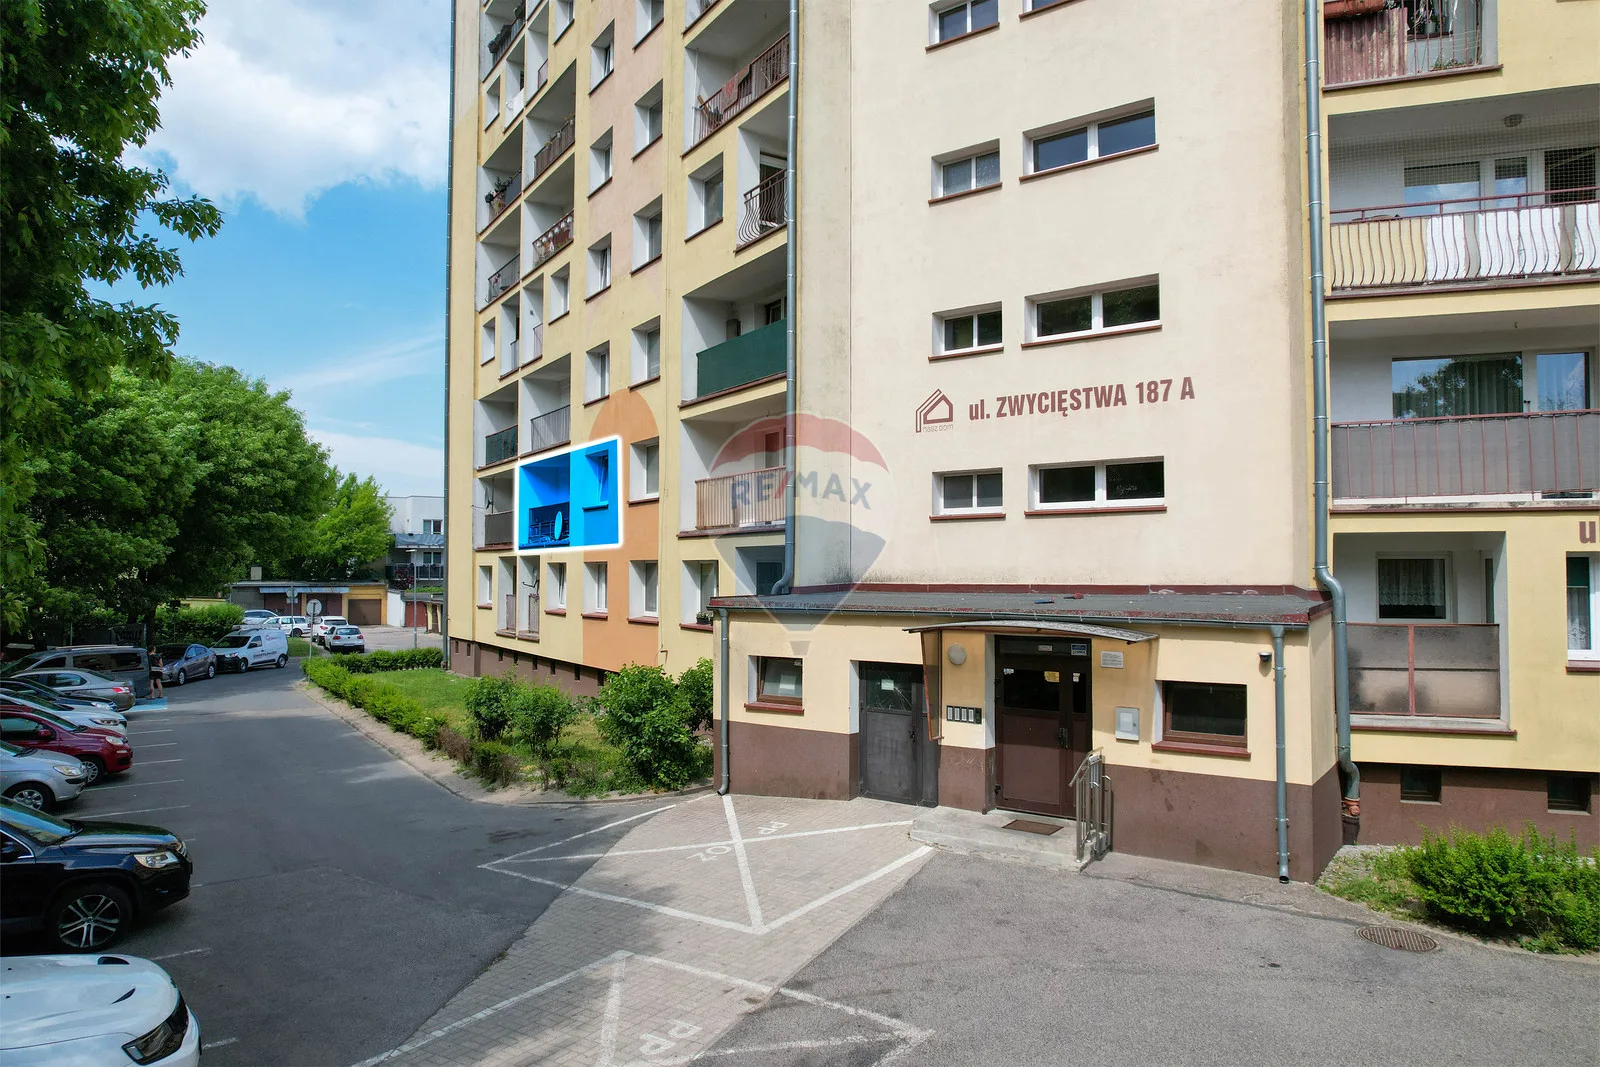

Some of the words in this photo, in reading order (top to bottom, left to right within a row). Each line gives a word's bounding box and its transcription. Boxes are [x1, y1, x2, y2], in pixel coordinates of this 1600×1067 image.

[969, 399, 991, 421] ul.
[996, 384, 1127, 417] ZWYCIĘSTWA
[1135, 379, 1173, 404] 187
[1180, 376, 1196, 401] A
[1579, 516, 1600, 544] u
